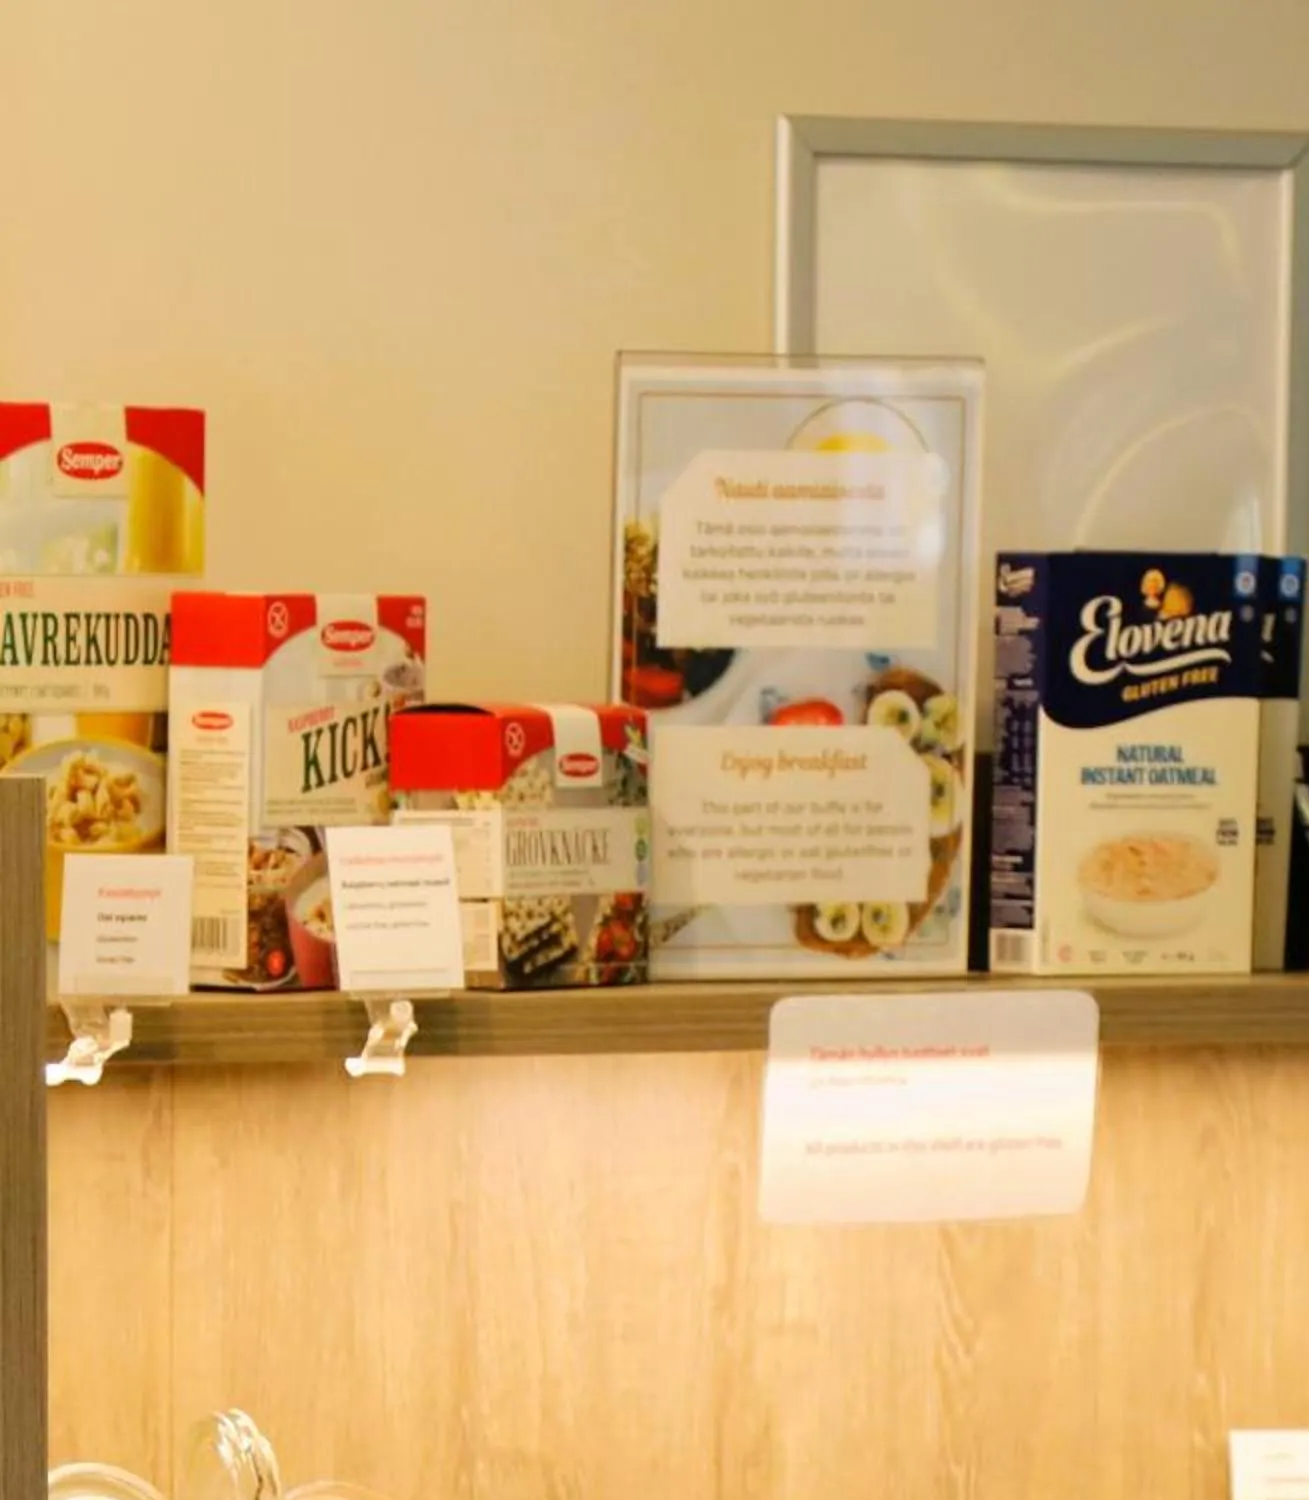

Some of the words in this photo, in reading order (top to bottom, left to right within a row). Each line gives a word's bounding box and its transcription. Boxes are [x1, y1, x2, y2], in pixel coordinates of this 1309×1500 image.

[61, 446, 121, 476] Semper
[1069, 596, 1233, 684] Elovena
[1121, 675, 1180, 703] GLUTEN
[1182, 665, 1219, 687] FREE
[1116, 744, 1184, 763] NATURAL
[1080, 766, 1144, 786] INSTANT
[1148, 766, 1218, 787] OATMEAL
